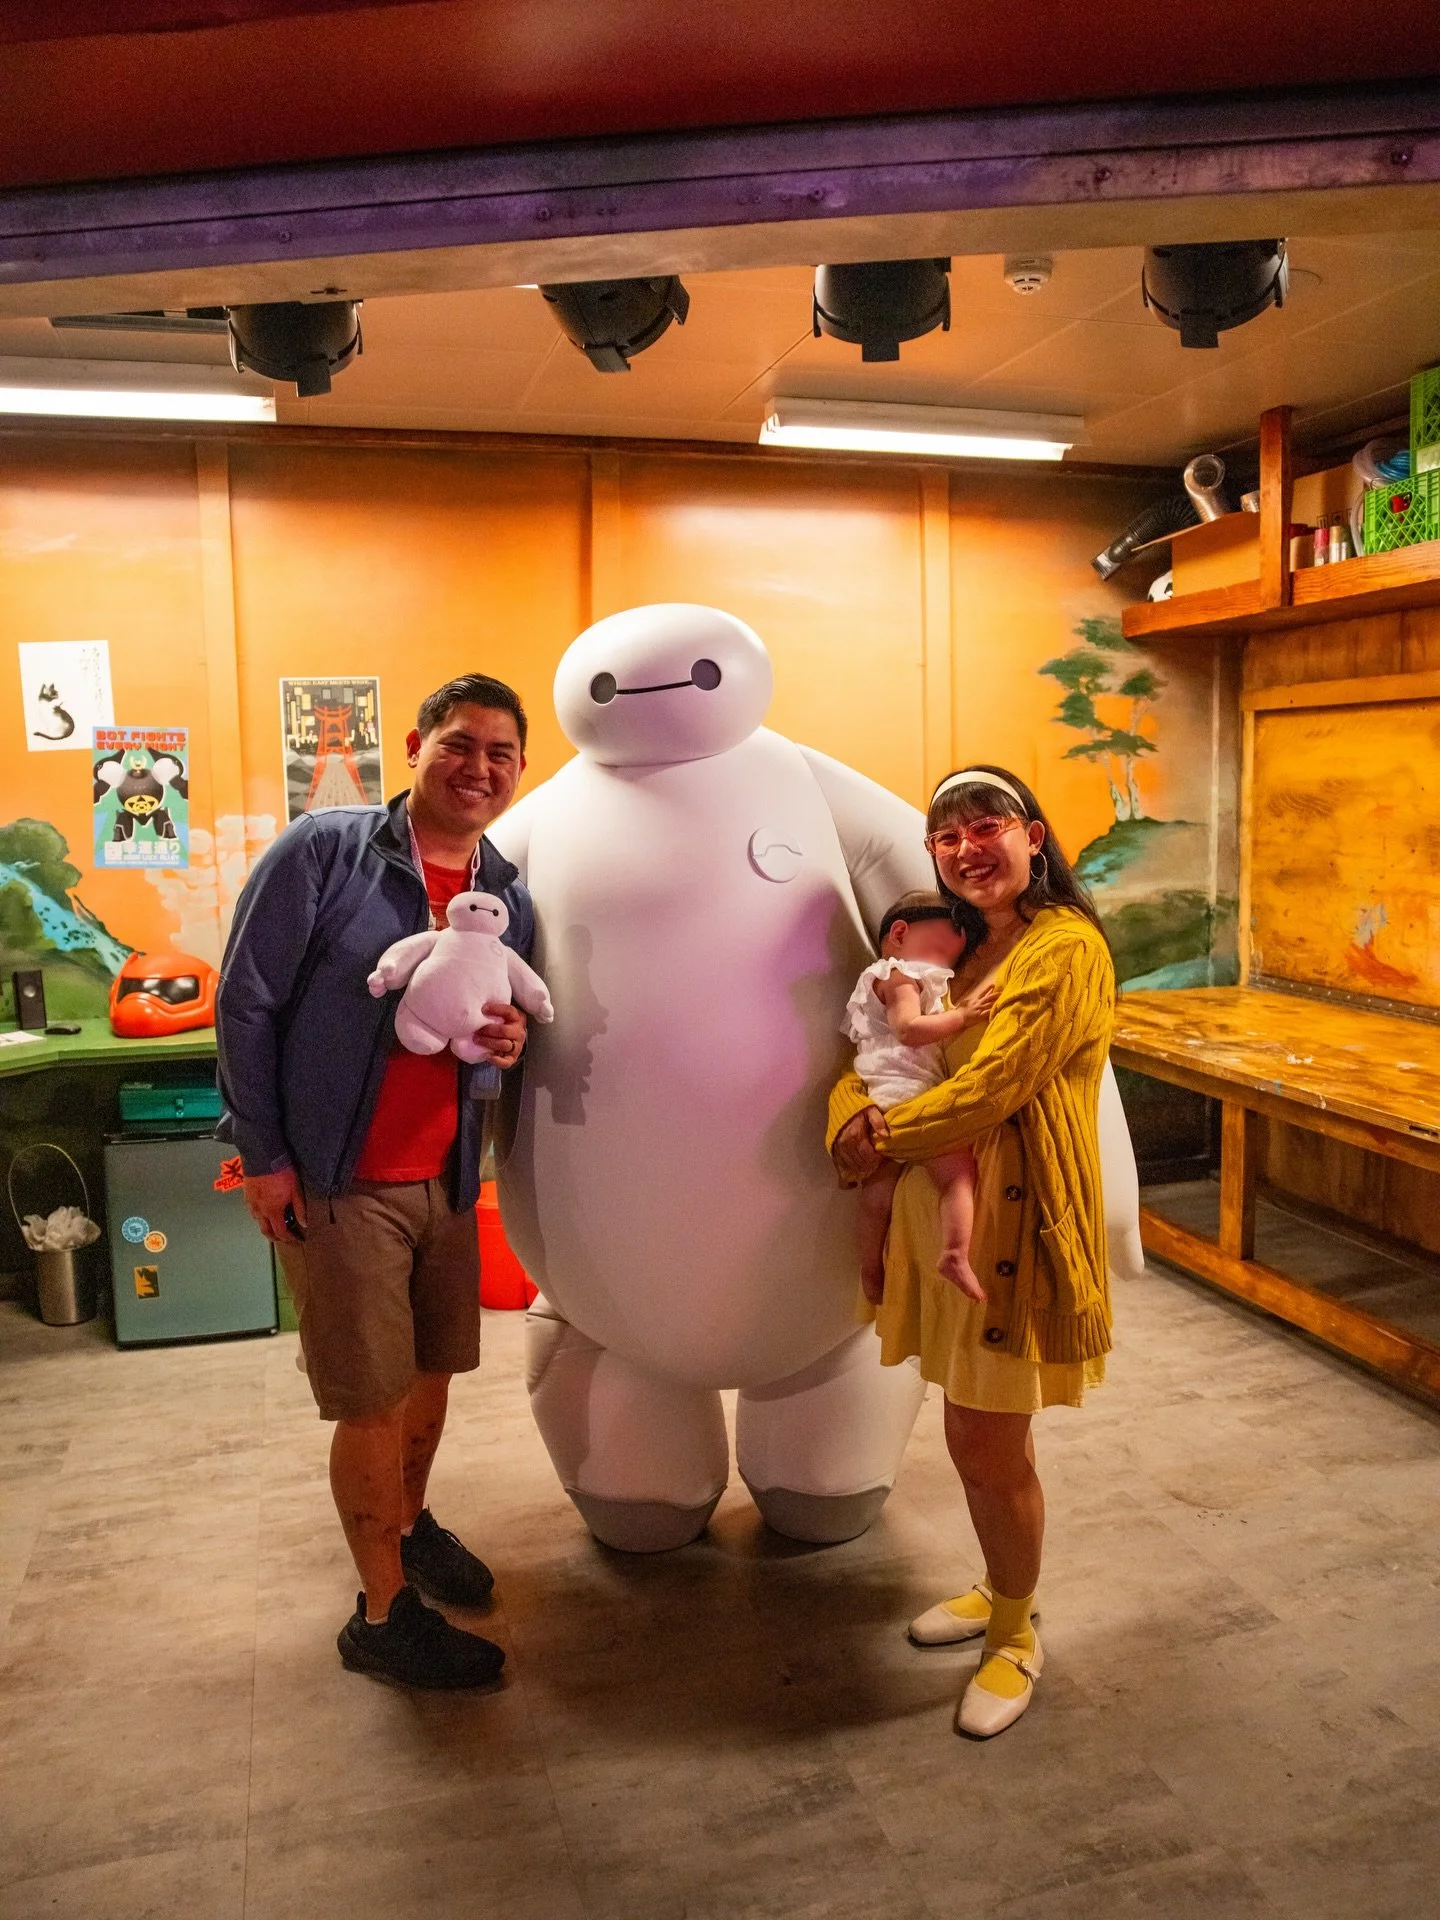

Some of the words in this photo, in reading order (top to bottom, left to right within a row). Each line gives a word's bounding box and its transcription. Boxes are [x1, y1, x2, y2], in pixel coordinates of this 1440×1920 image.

[96, 730, 127, 741] BOT
[131, 731, 186, 742] FIGHTS
[96, 741, 142, 751] EVERY
[145, 742, 186, 752] NIGHT
